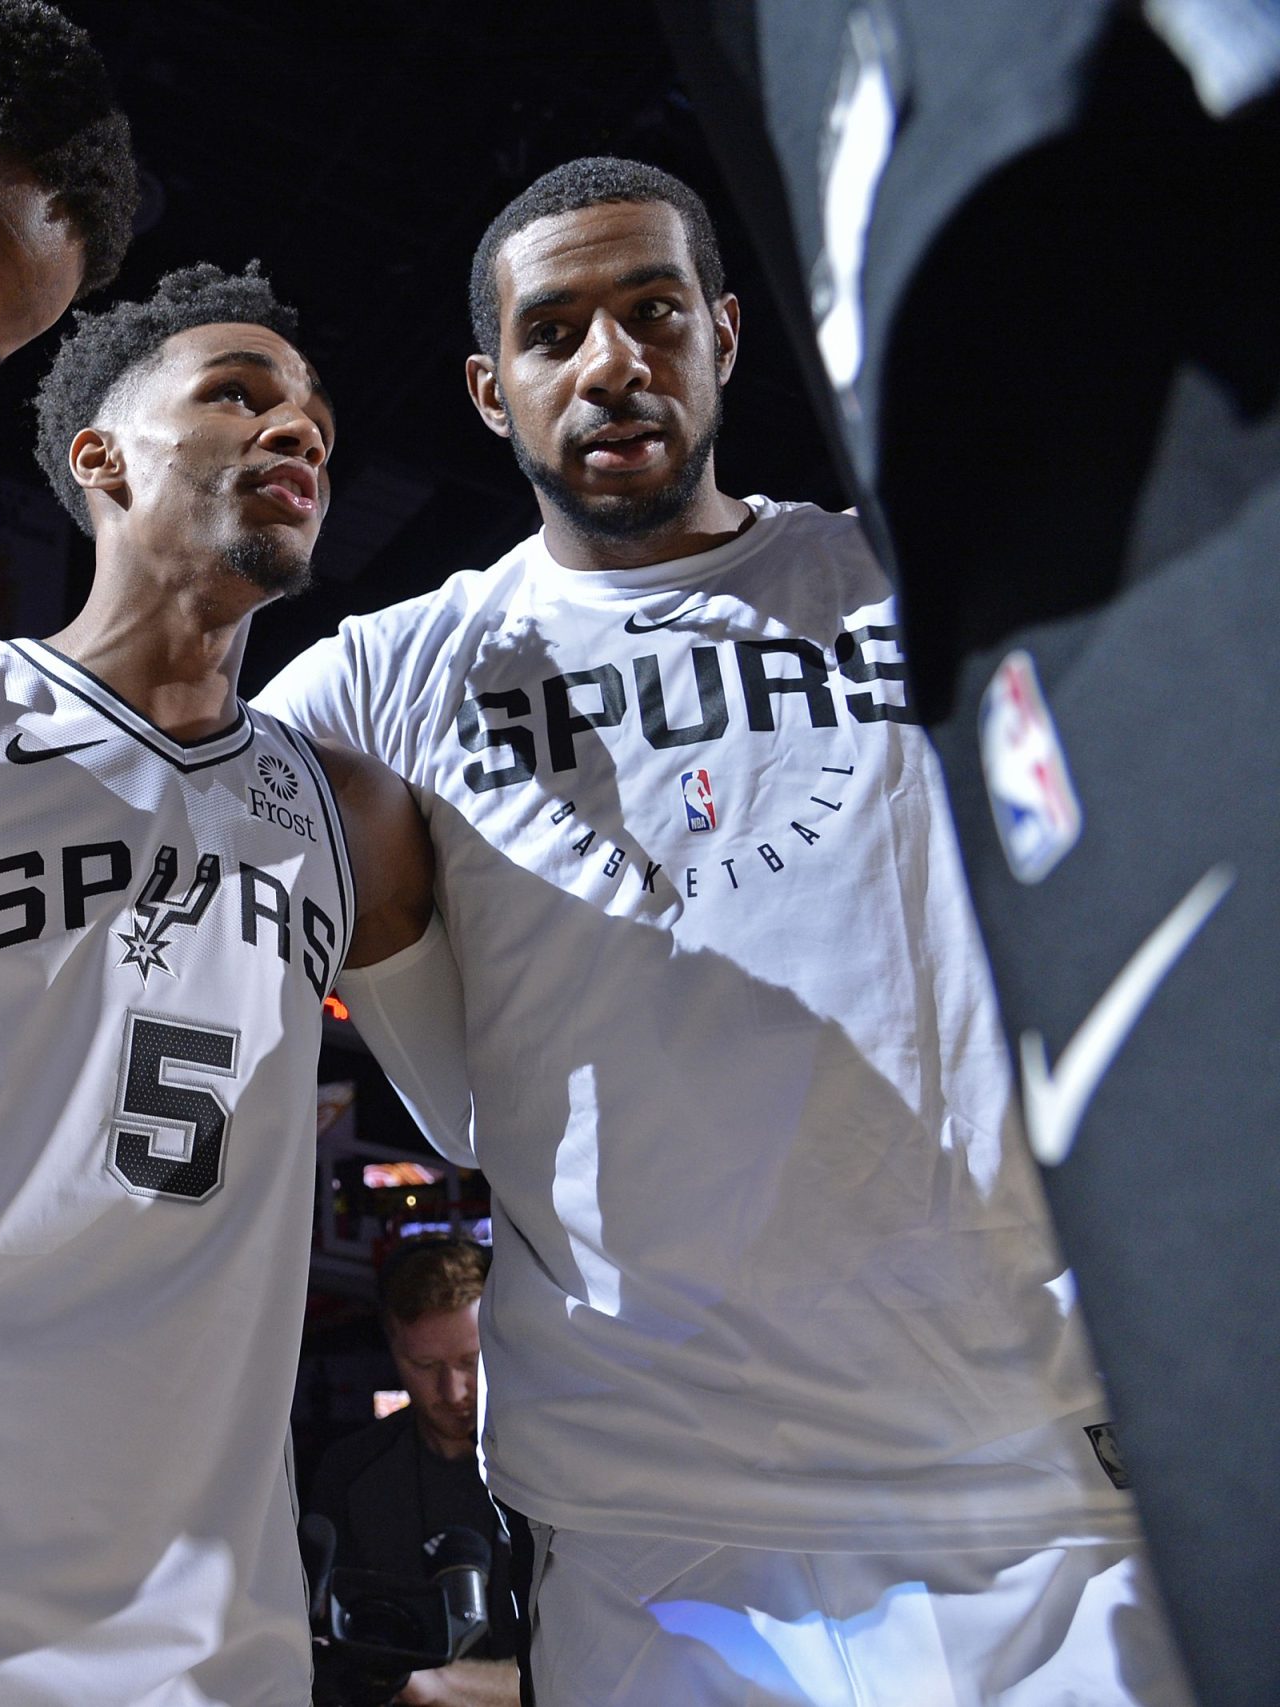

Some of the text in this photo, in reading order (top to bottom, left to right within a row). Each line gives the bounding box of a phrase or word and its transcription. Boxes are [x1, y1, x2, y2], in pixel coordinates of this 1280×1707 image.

[456, 624, 923, 793] SPURS
[247, 786, 318, 843] Frost
[550, 765, 854, 897] BASKETBALL
[691, 816, 706, 830] NBA
[105, 1006, 242, 1207] 5
